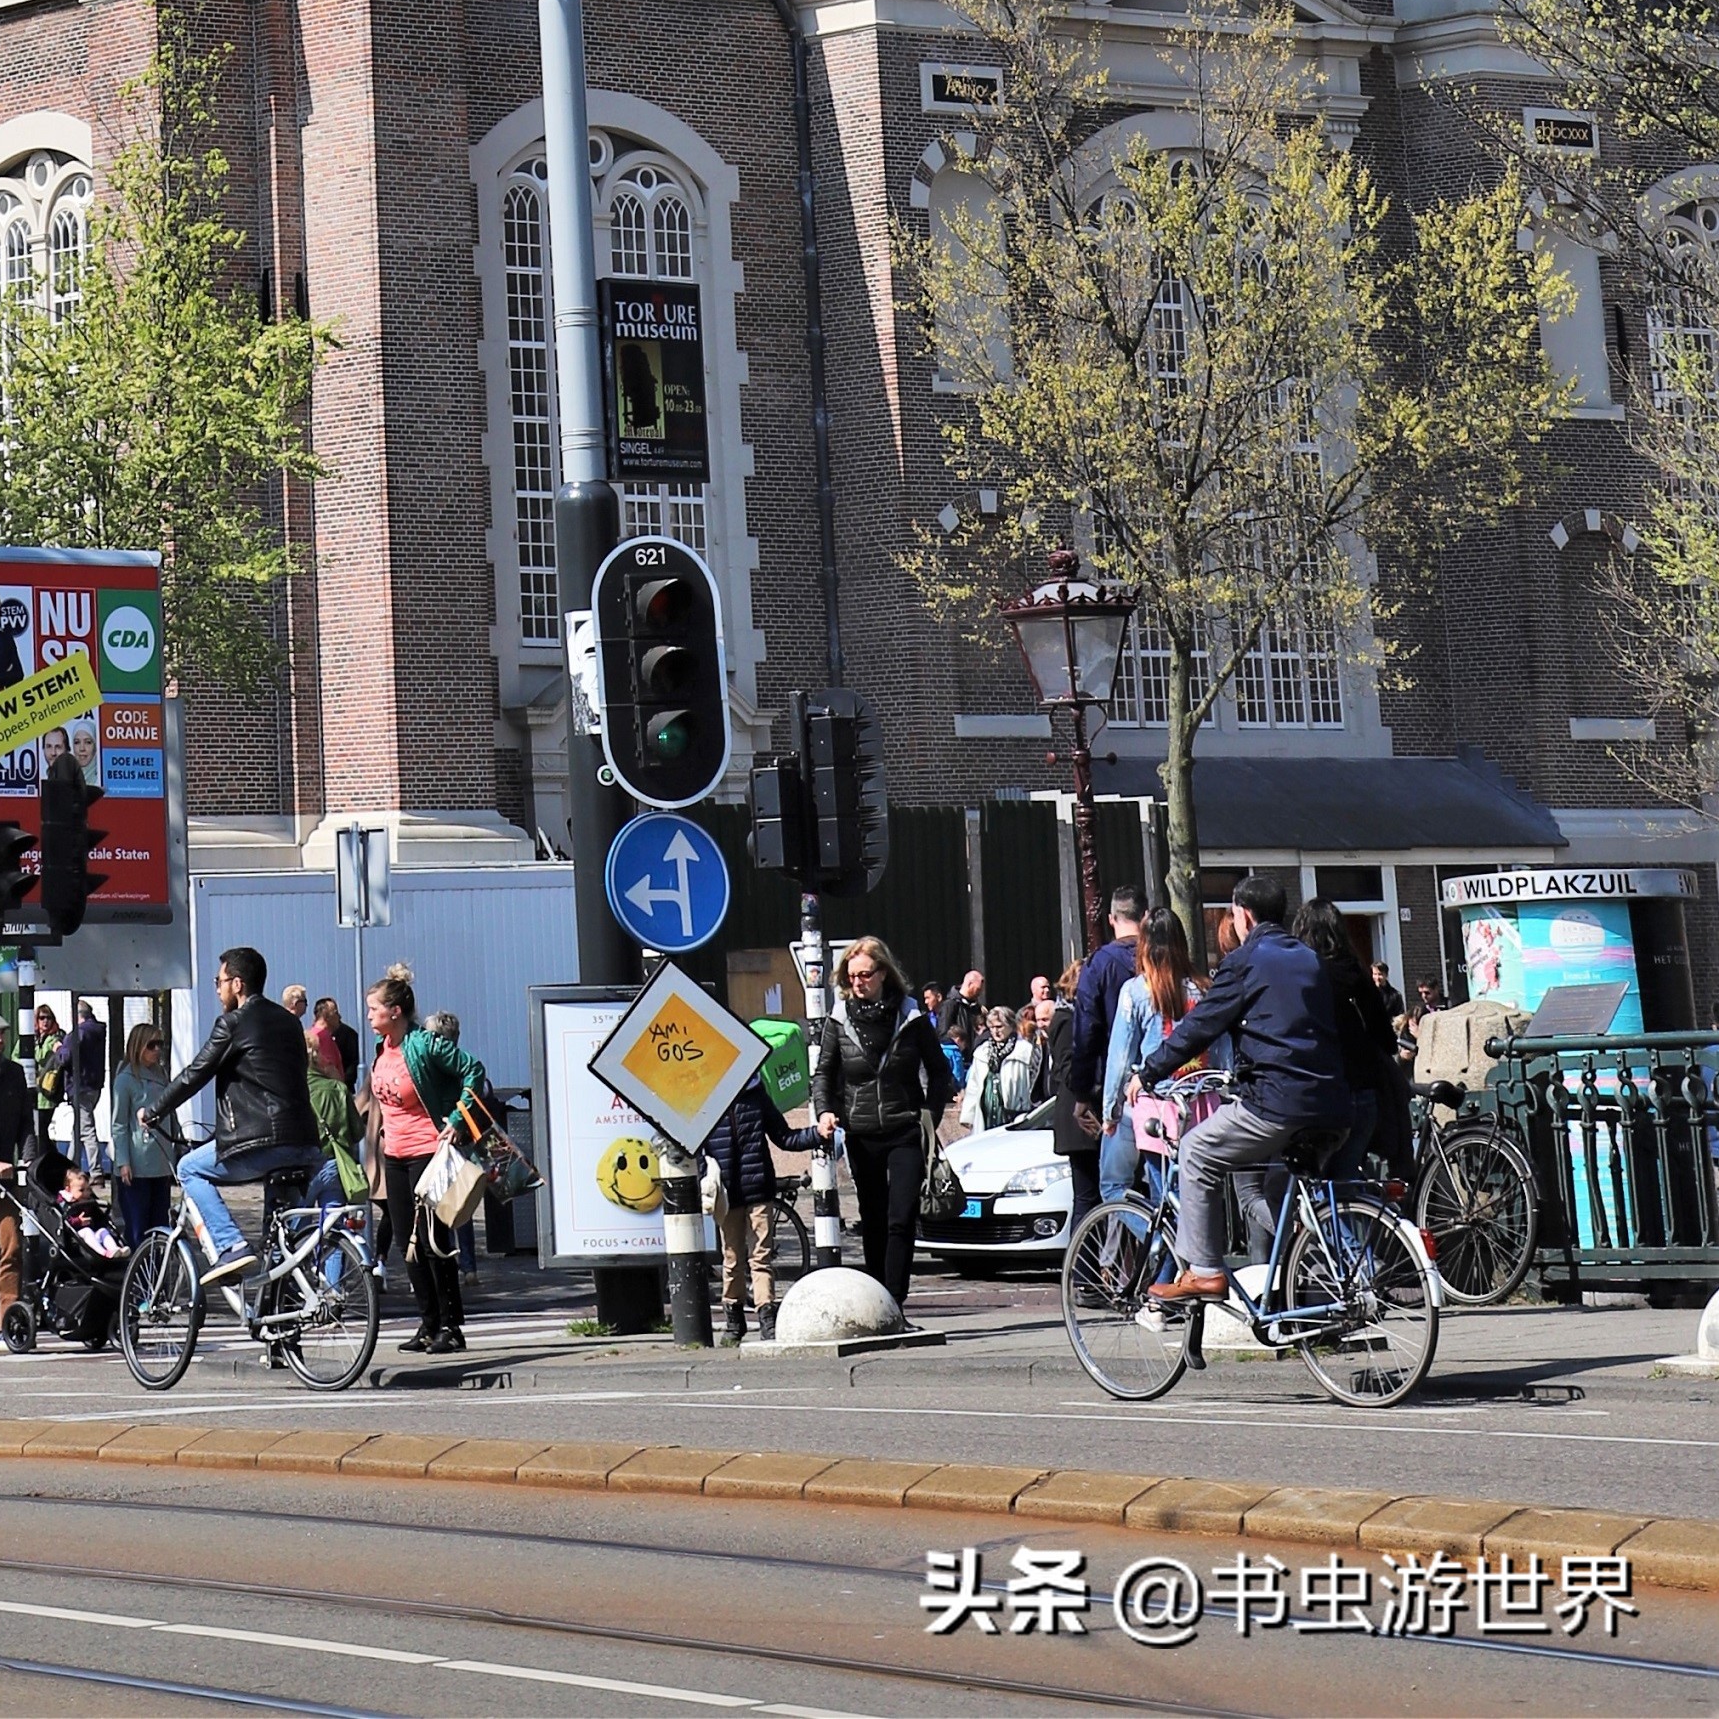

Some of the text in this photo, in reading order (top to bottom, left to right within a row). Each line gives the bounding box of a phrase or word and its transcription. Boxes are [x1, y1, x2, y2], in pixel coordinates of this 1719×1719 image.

[616, 321, 698, 341] museum
[620, 442, 653, 455] SINGEL
[635, 547, 667, 566] 621
[1, 606, 25, 616] STEM
[39, 591, 92, 638] NU
[0, 614, 28, 629] PVV
[108, 630, 149, 649] CDA
[22, 666, 80, 708] STEM!
[30, 688, 87, 725] Parlement
[113, 710, 149, 724] CODE
[106, 726, 159, 741] ORANJE
[5, 748, 38, 781] 10
[111, 756, 154, 767] DOE MEE!
[107, 769, 159, 780] BESLIS MEE!
[115, 848, 150, 861] Staten
[1463, 873, 1637, 900] WILDPLAKZUIL
[592, 1014, 614, 1024] 35TH
[658, 1039, 704, 1062] GOS
[774, 1058, 798, 1079] Uber
[778, 1071, 802, 1092] Eats
[583, 1237, 666, 1248] FOCUS CATAL
